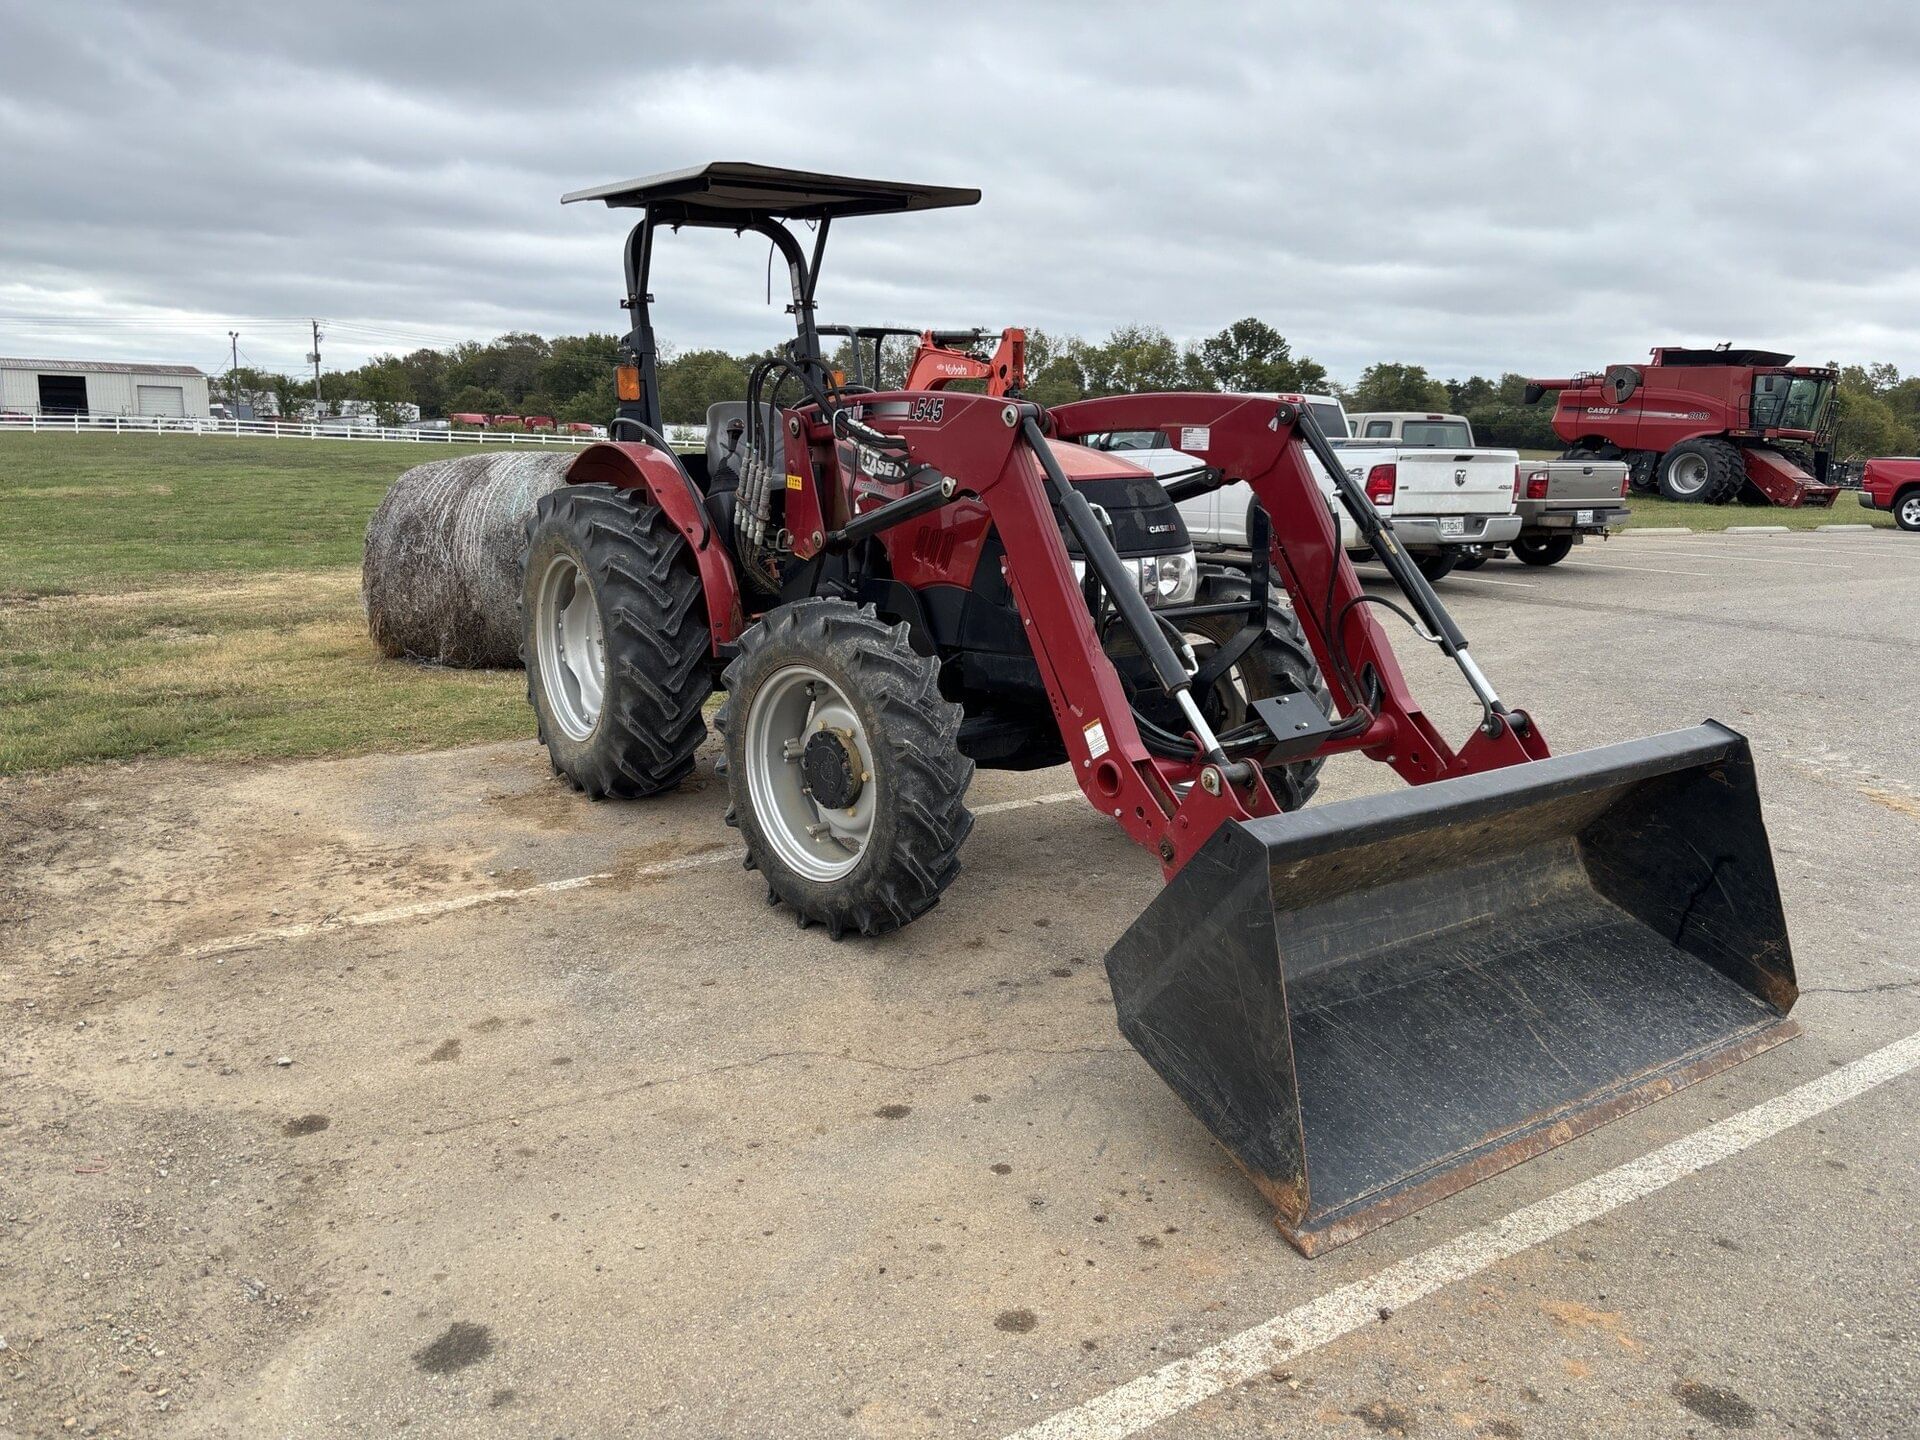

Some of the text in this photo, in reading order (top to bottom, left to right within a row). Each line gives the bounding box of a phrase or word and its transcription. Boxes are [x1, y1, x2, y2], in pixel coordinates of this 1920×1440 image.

[945, 364, 967, 375] Kubota
[909, 398, 945, 423] L545
[1149, 524, 1170, 533] CASE
